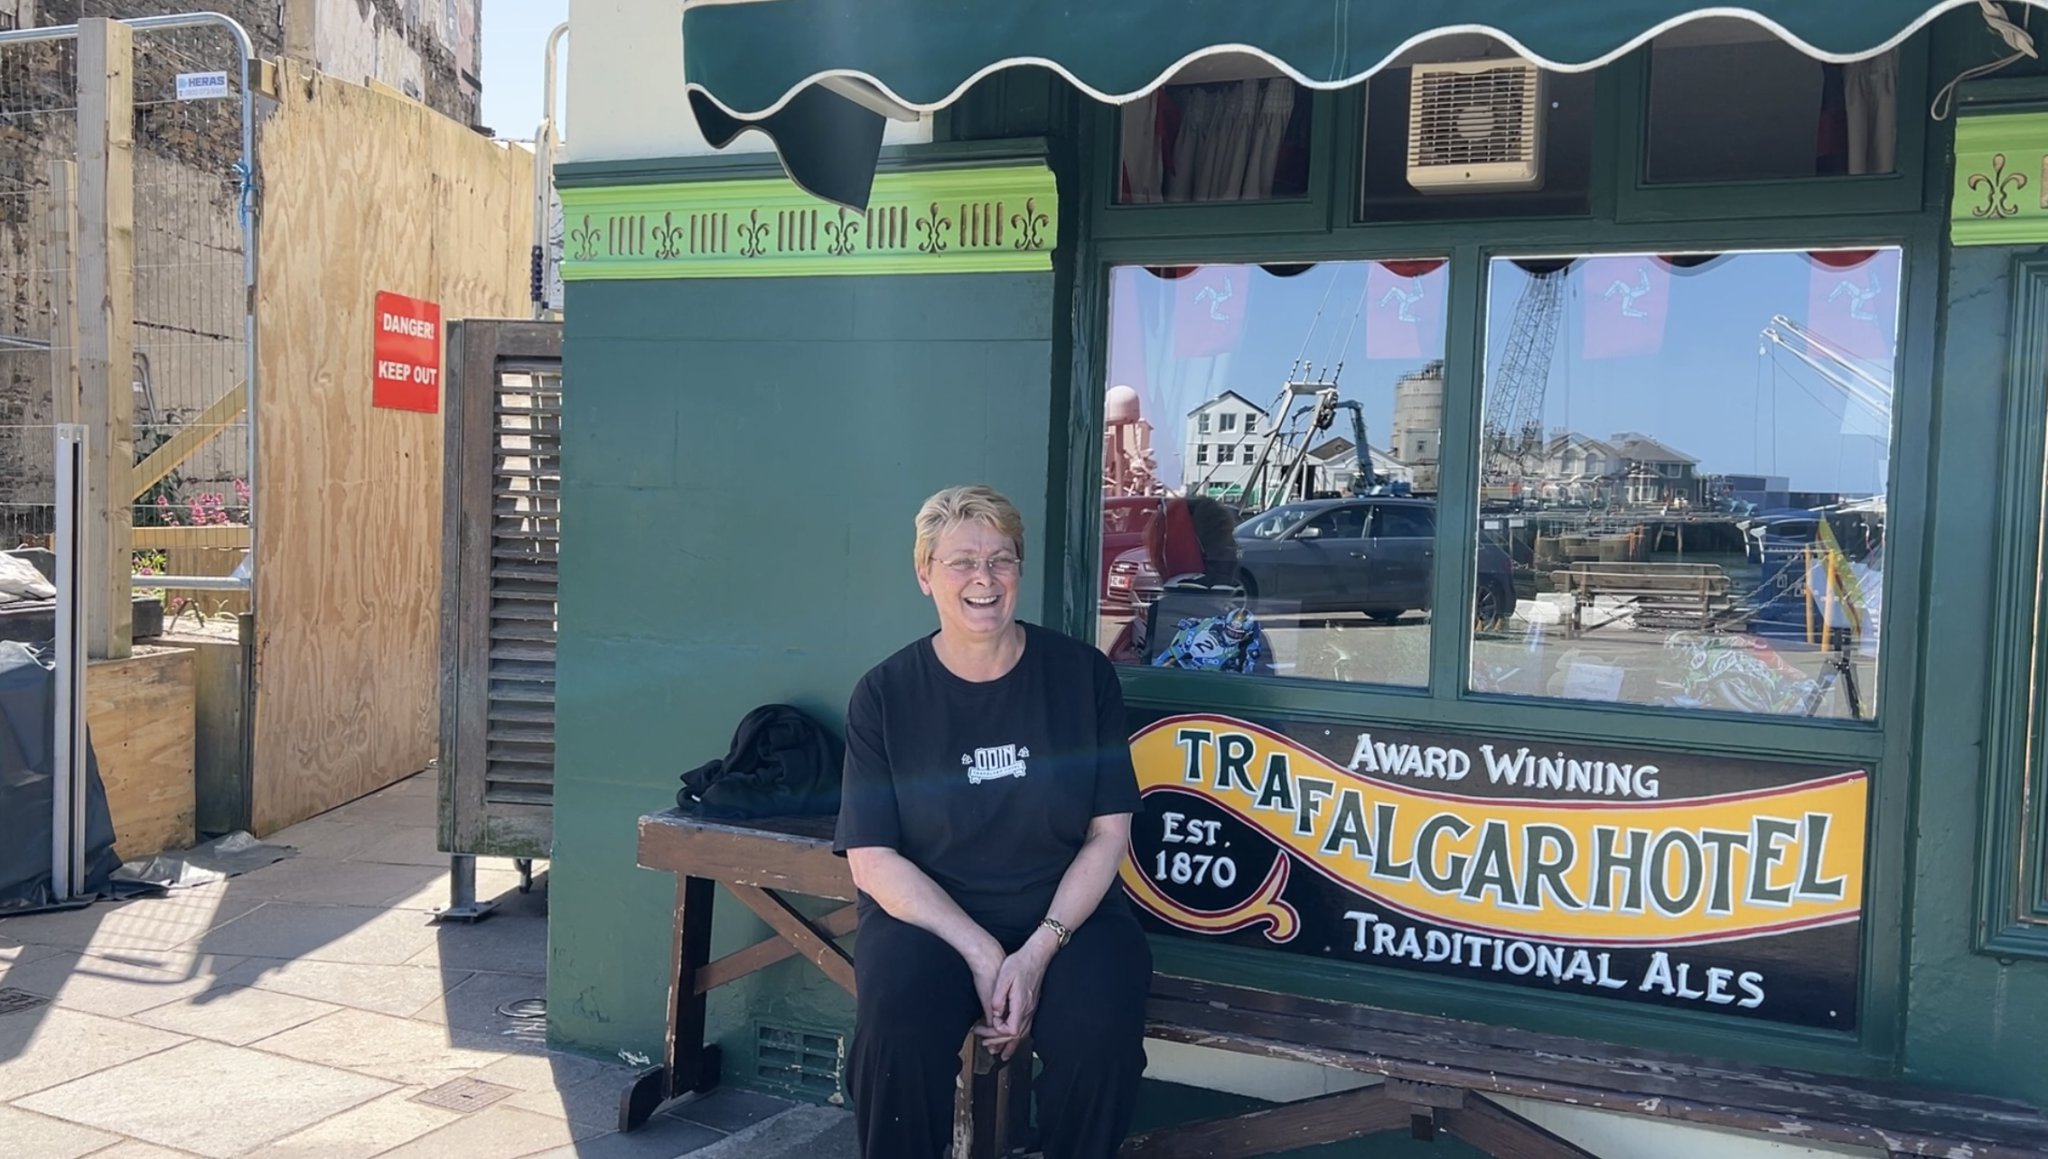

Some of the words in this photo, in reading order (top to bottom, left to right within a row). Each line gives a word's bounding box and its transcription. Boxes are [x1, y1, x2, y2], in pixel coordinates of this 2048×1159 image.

[188, 76, 225, 87] HERAS
[383, 312, 435, 340] DANGER!
[378, 360, 411, 381] KEEP
[413, 366, 437, 385] OUT
[1346, 732, 1471, 781] AWARD
[1479, 744, 1660, 798] WINNING
[1161, 811, 1231, 848] EST.
[1176, 727, 1587, 911] TRAFALGAR
[1588, 811, 1848, 917] HOTEL
[1154, 849, 1237, 888] 1870
[1343, 910, 1628, 989] TRADITIONAL
[1638, 950, 1765, 1010] ALES
